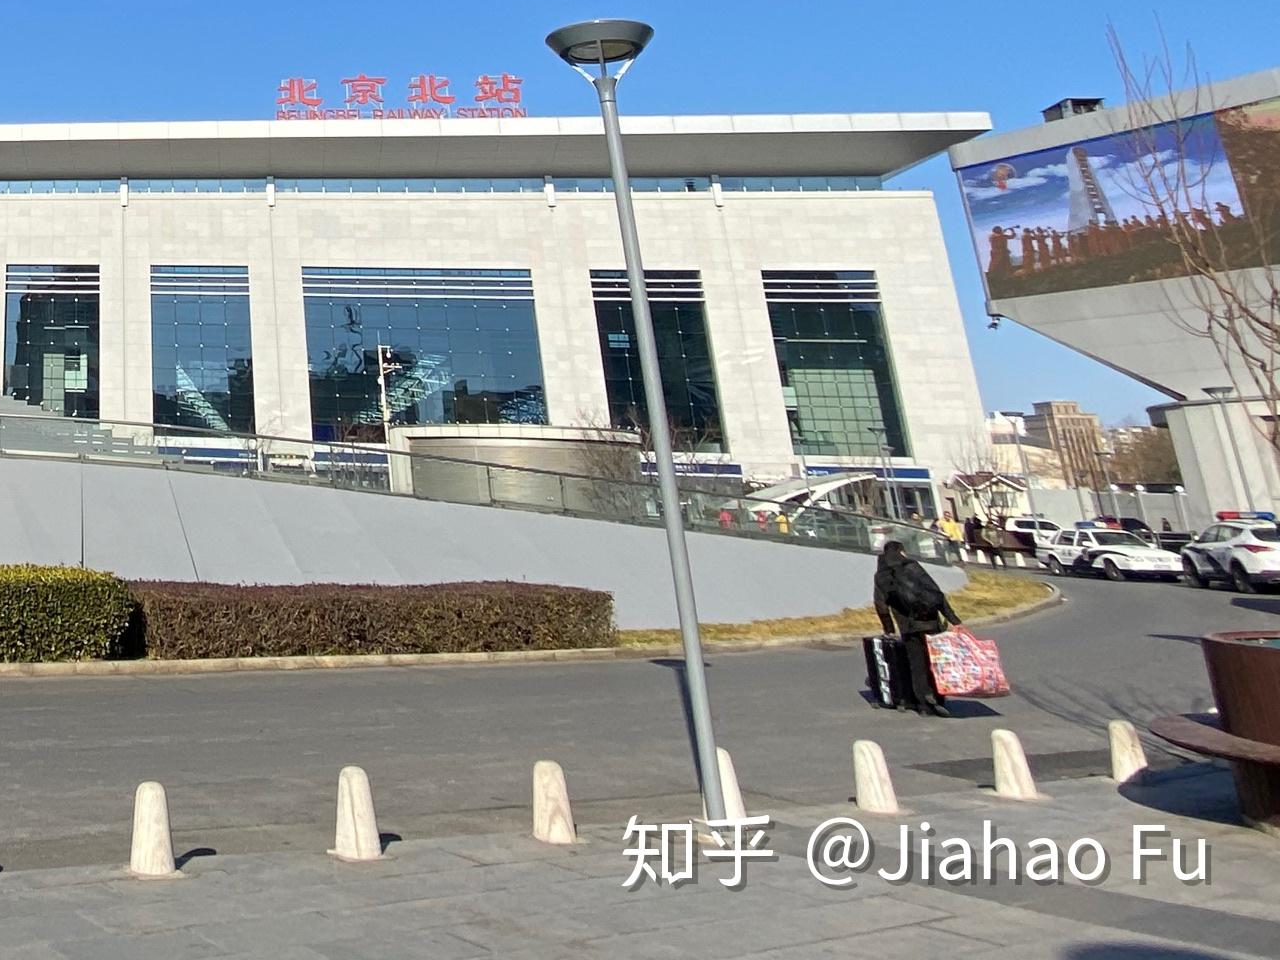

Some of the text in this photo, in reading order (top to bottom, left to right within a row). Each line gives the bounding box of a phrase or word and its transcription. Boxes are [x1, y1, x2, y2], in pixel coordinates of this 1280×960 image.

[276, 73, 524, 106] 北京北站
[457, 108, 527, 119] STATION
